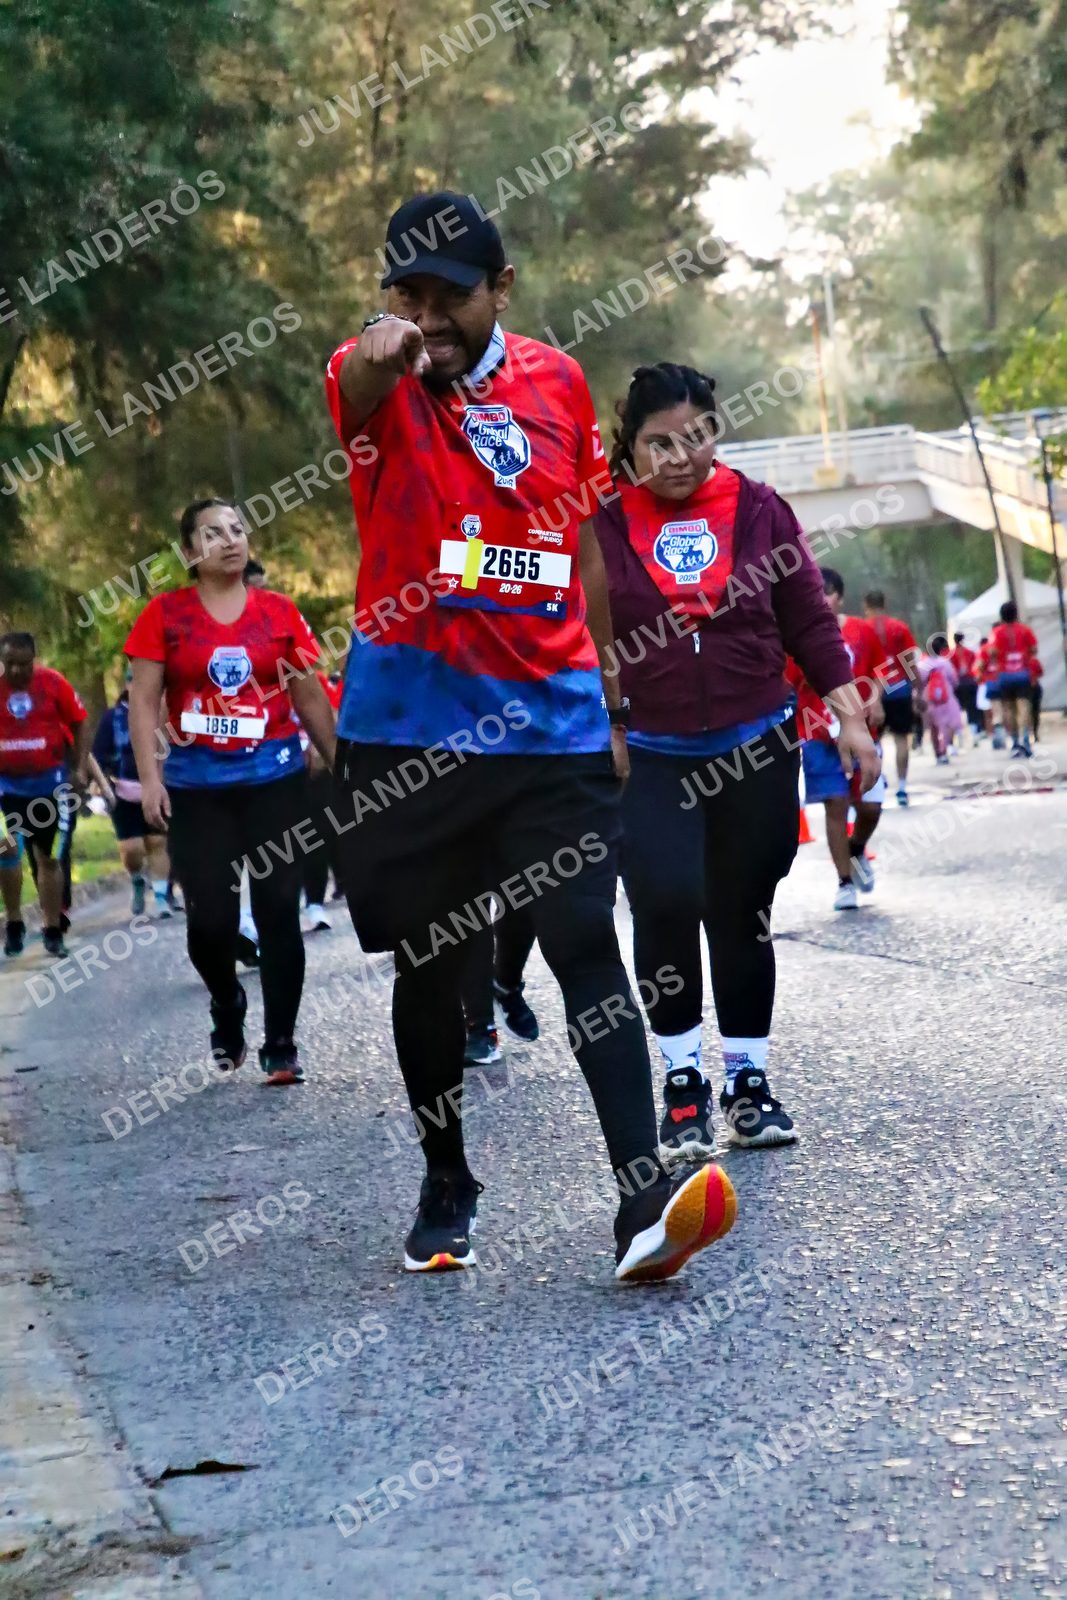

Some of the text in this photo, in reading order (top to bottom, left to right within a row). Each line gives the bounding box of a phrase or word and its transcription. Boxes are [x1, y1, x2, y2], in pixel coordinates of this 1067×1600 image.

[472, 434, 503, 447] Race
[670, 535, 702, 547] Global
[663, 545, 690, 556] Race
[483, 547, 541, 581] 2655
[679, 574, 698, 583] 2026
[546, 602, 558, 612] 5K
